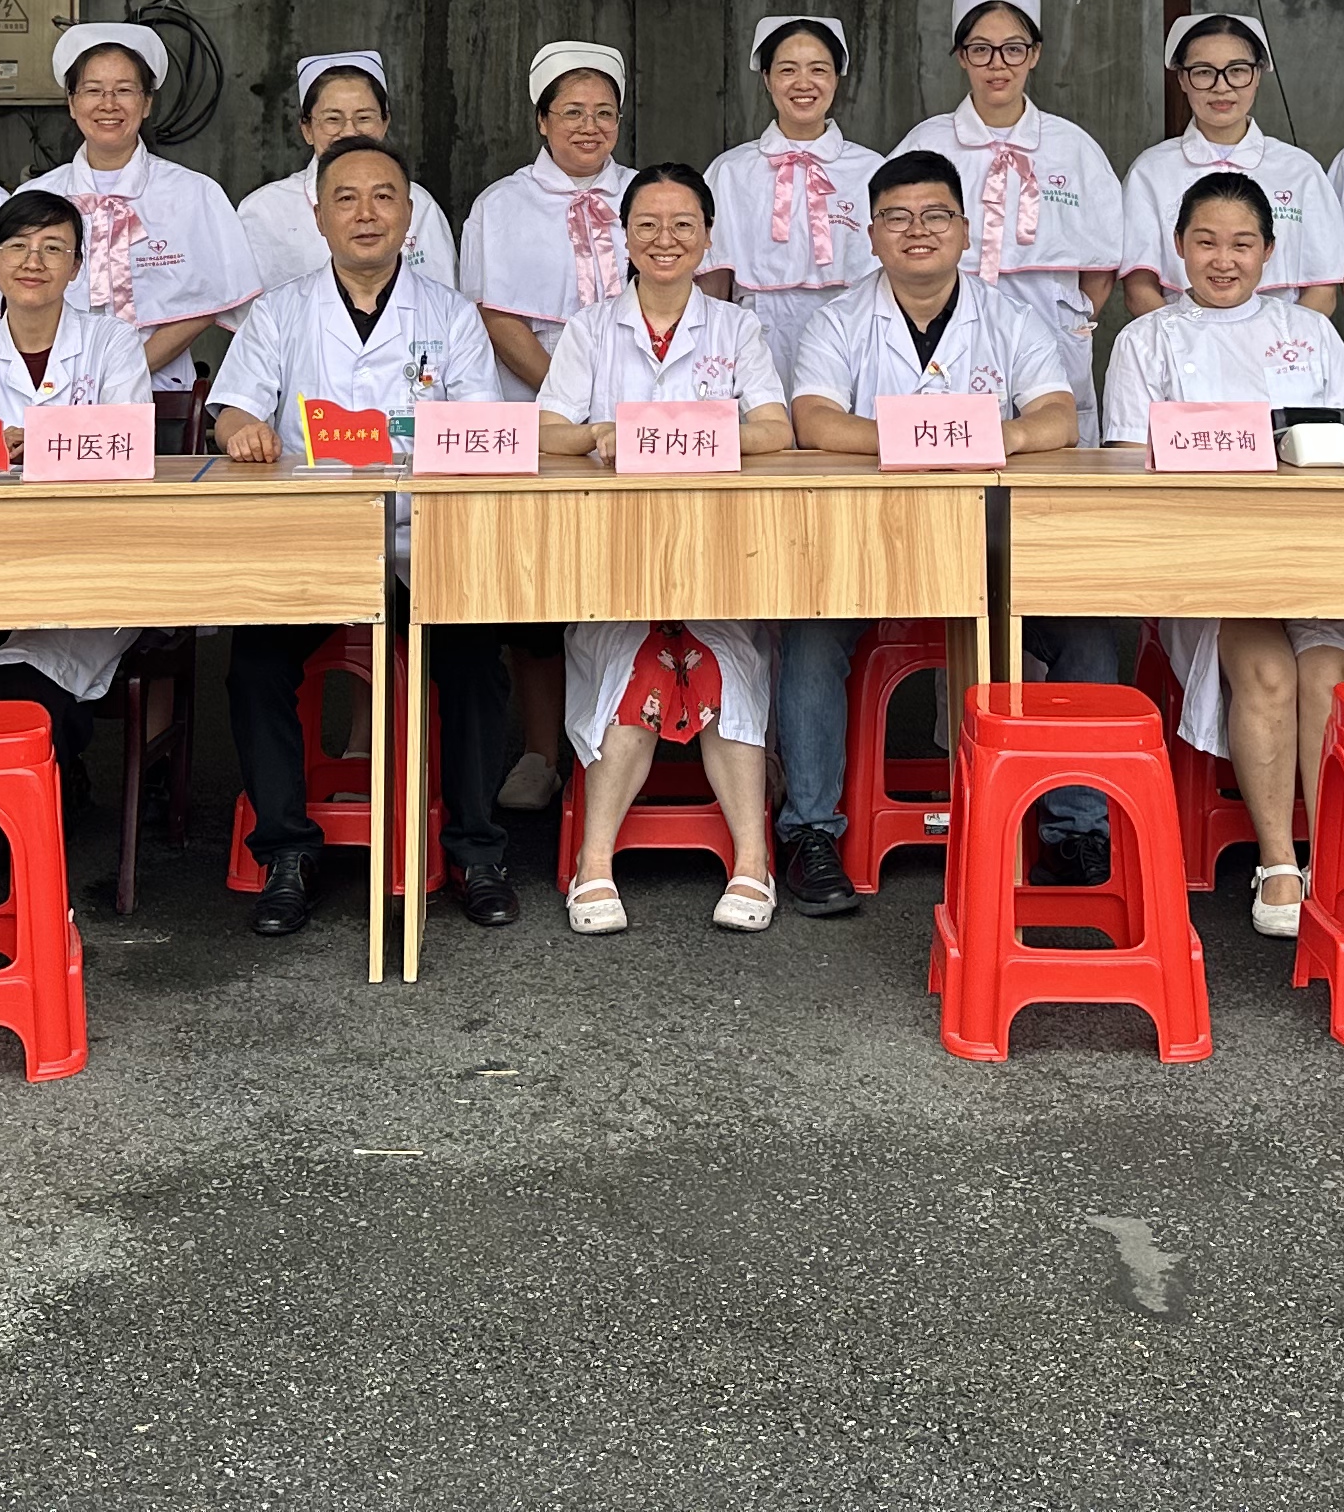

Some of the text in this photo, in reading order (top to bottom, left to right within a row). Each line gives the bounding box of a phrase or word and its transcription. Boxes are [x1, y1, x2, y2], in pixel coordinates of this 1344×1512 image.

[47, 432, 134, 462] 中医科
[317, 427, 380, 442] 党员先锋岗
[436, 427, 520, 455] 中医科
[636, 426, 719, 458] 肾内科
[913, 419, 973, 448] 内科
[1169, 429, 1256, 453] 心理咨询
